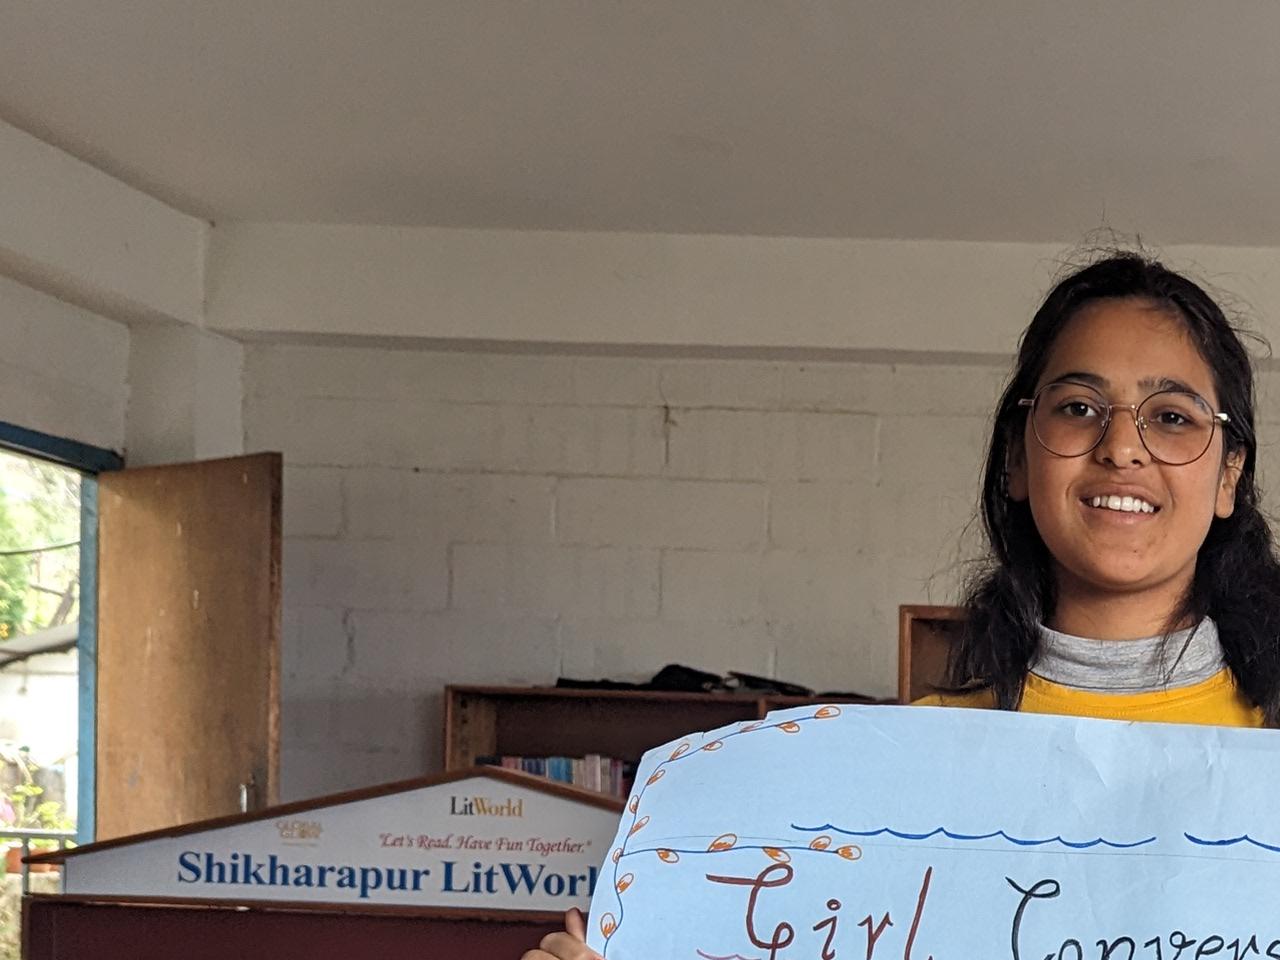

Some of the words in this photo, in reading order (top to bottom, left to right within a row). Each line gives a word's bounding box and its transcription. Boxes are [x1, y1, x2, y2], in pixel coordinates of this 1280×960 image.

[449, 796, 524, 818] LitWorld
[457, 834, 492, 850] Have
[497, 837, 526, 852] Fun
[177, 851, 431, 899] Shikharapur
[441, 861, 597, 897] LitWorl
